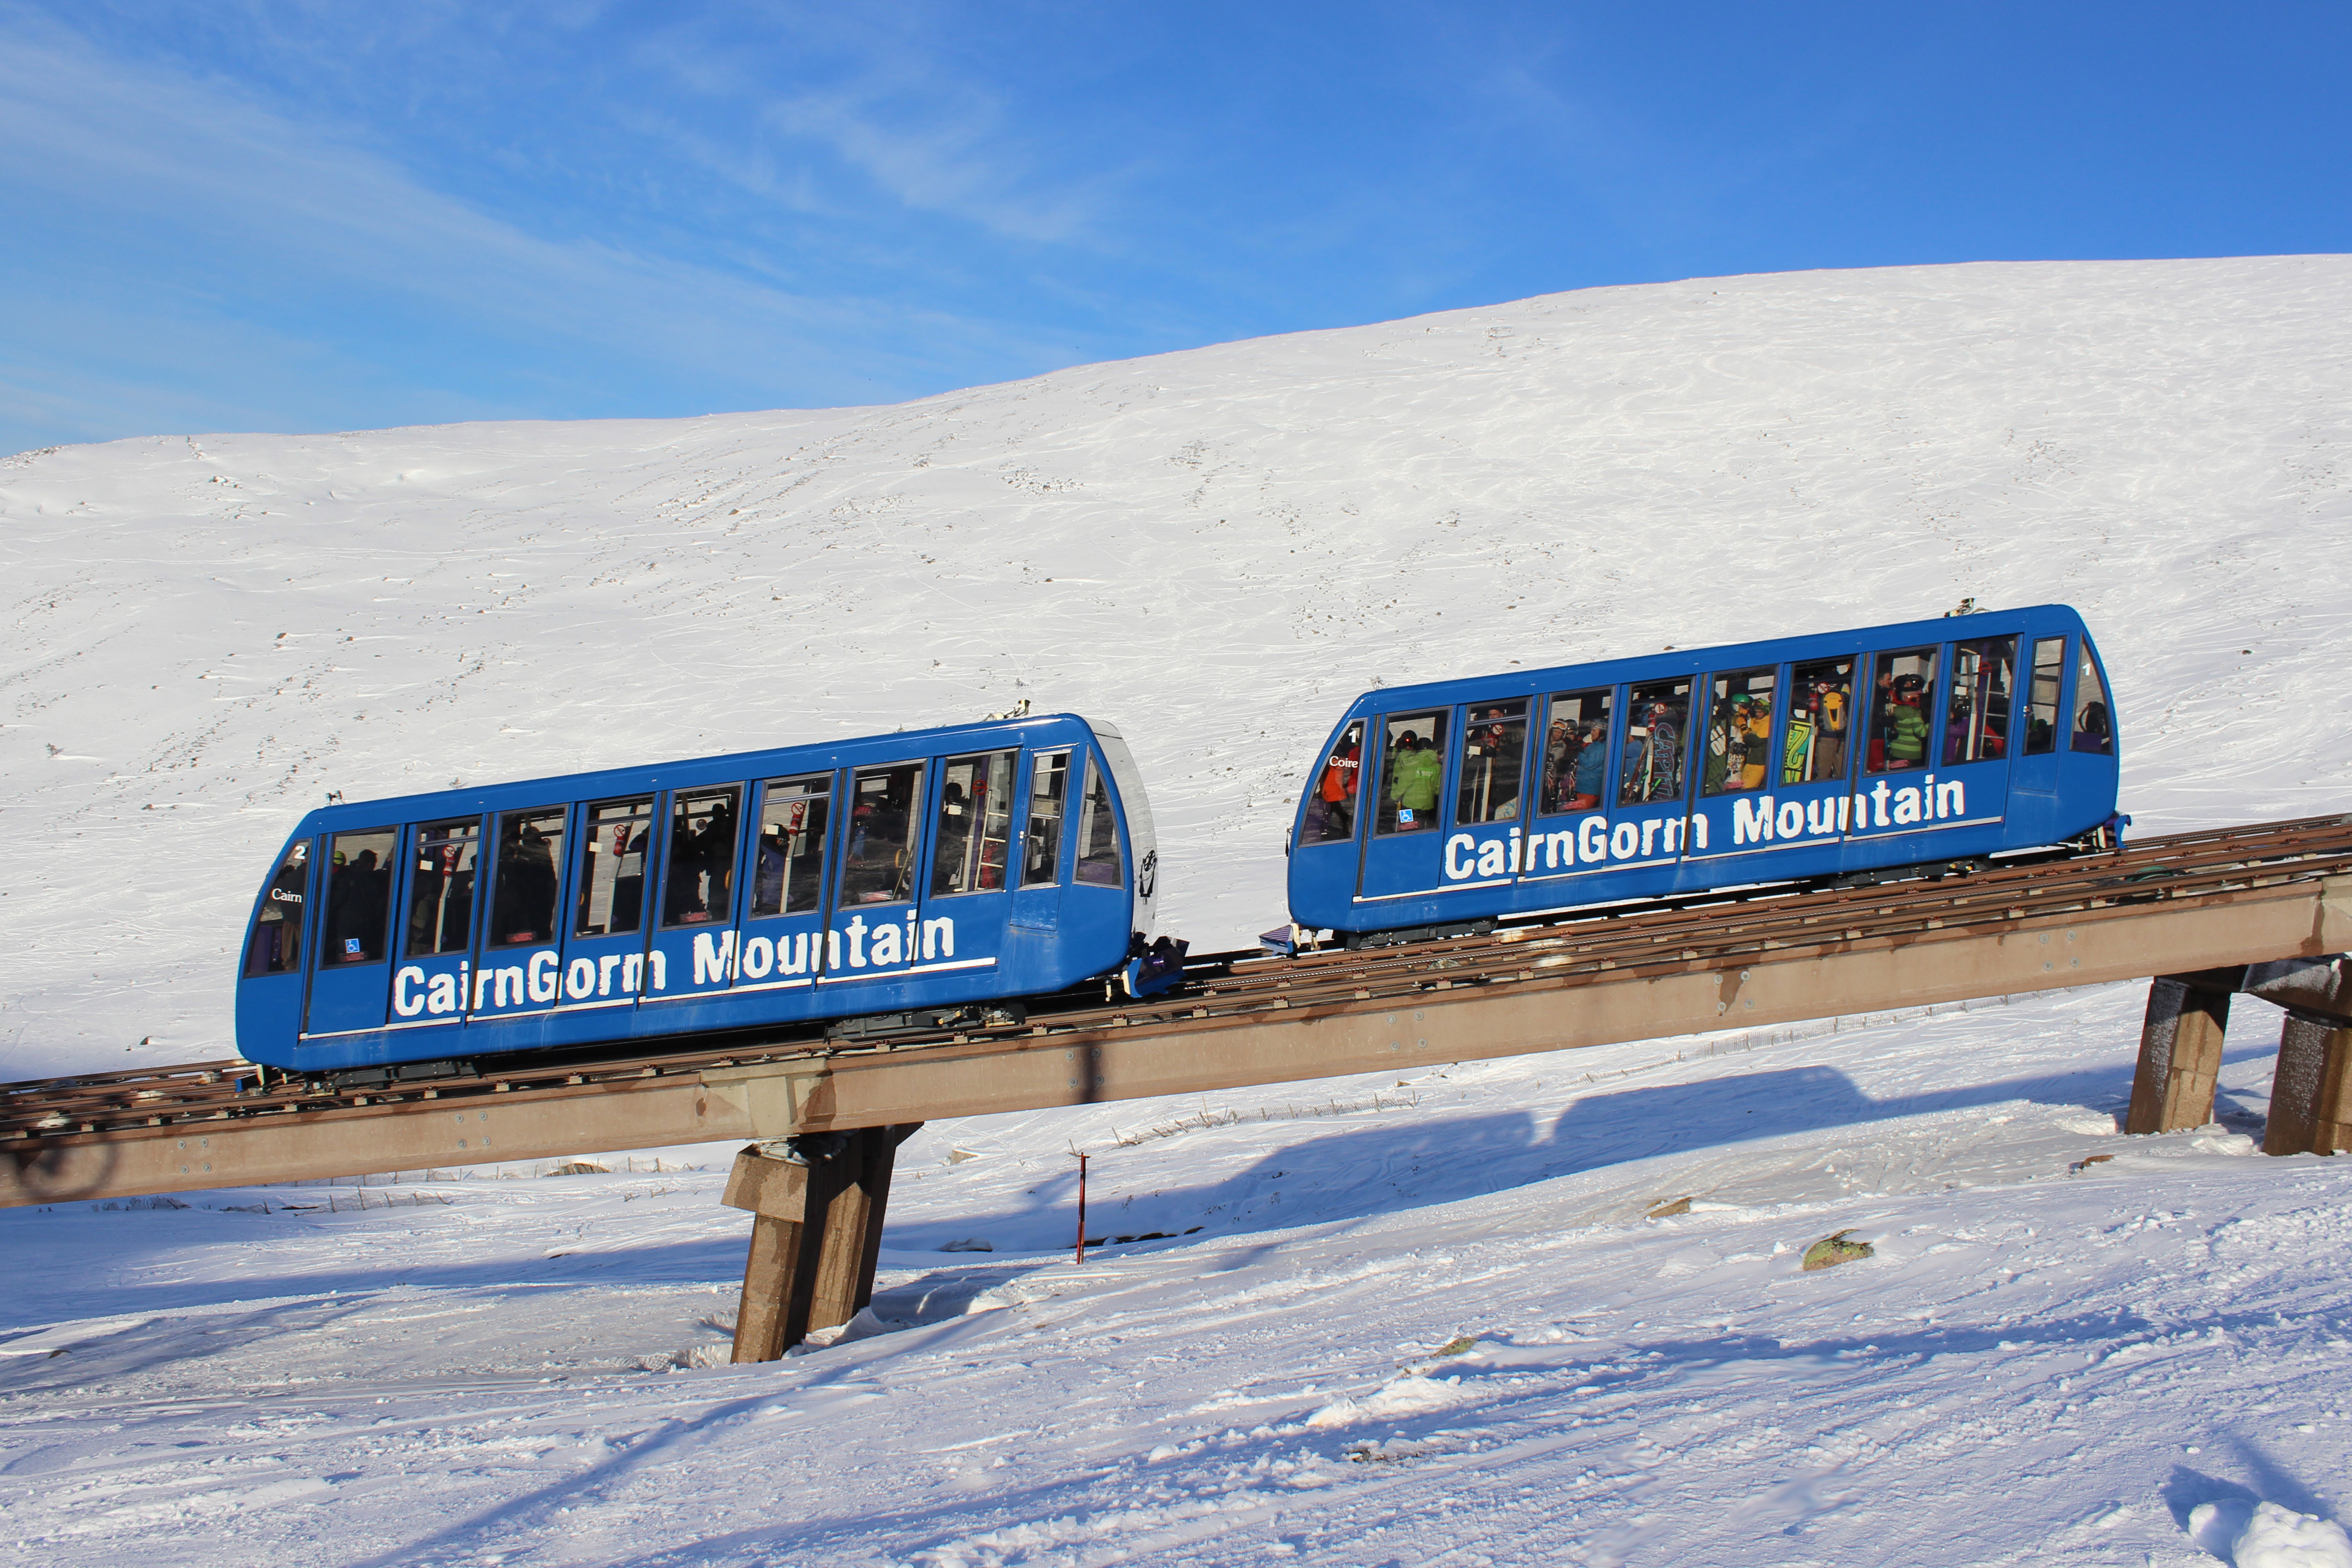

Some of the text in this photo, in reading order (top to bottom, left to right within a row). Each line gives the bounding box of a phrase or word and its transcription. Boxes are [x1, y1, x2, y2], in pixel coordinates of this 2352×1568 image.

[2082, 663, 2090, 676] 1
[1348, 730, 1357, 743] 1
[1329, 755, 1359, 768] Coire
[1445, 774, 1964, 879] CairnGorm Mountain
[293, 845, 306, 859] 2
[271, 888, 302, 903] Cairn
[395, 909, 954, 1016] CairnGorm Mountain
